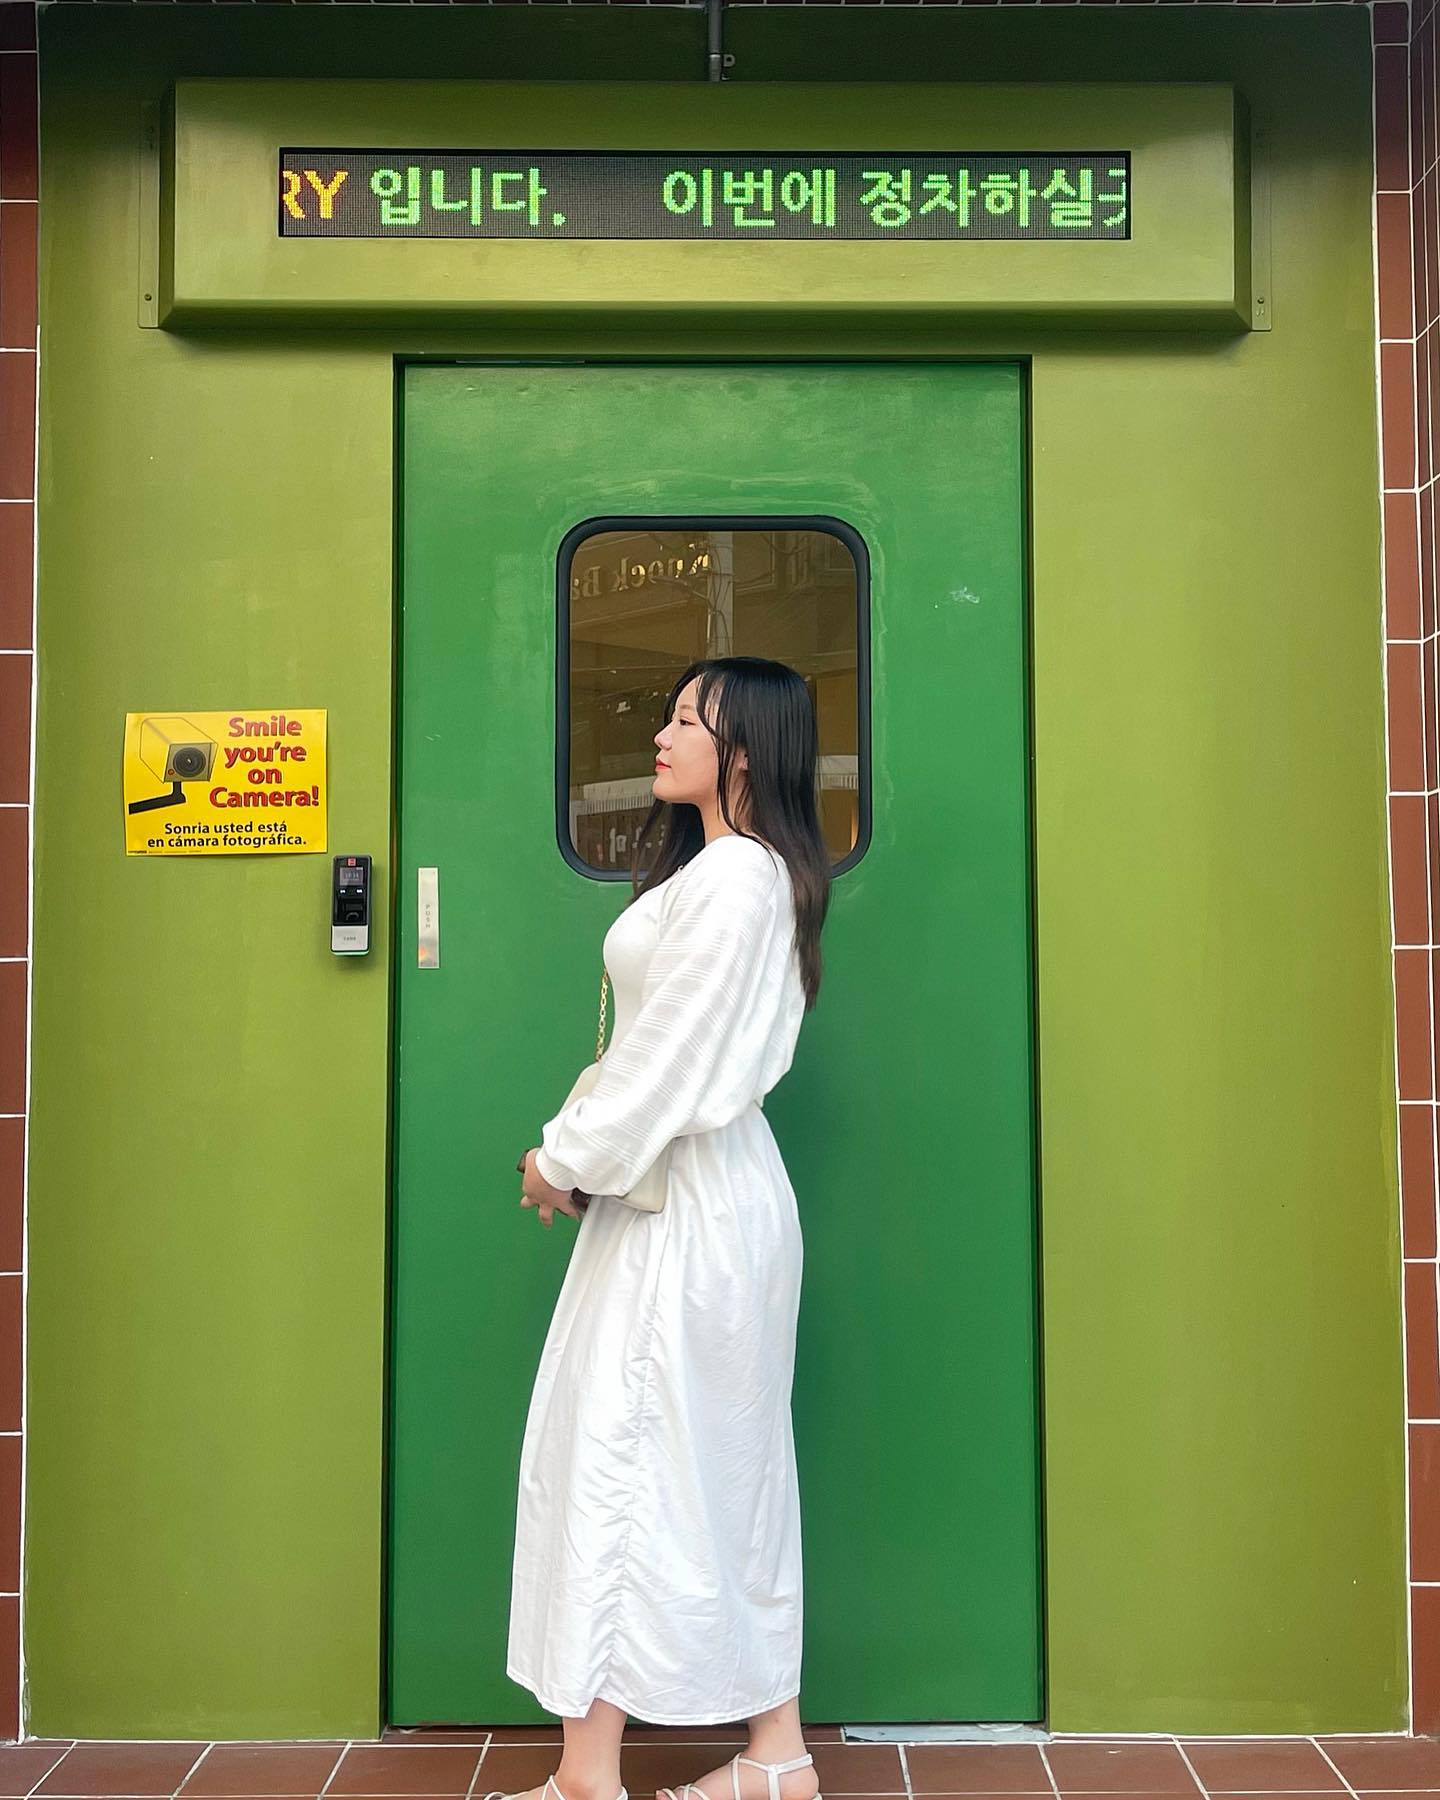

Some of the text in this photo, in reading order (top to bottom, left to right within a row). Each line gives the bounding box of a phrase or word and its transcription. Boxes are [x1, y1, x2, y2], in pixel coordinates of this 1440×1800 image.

[370, 167, 566, 226] 입니다.
[663, 168, 836, 228] 이번에
[228, 715, 303, 738] Smile
[224, 741, 307, 769] you're
[247, 767, 283, 785] on
[209, 785, 320, 808] Camera!
[214, 821, 253, 834] usted
[257, 820, 288, 833] está
[147, 834, 307, 849] en cámara fotográfica.
